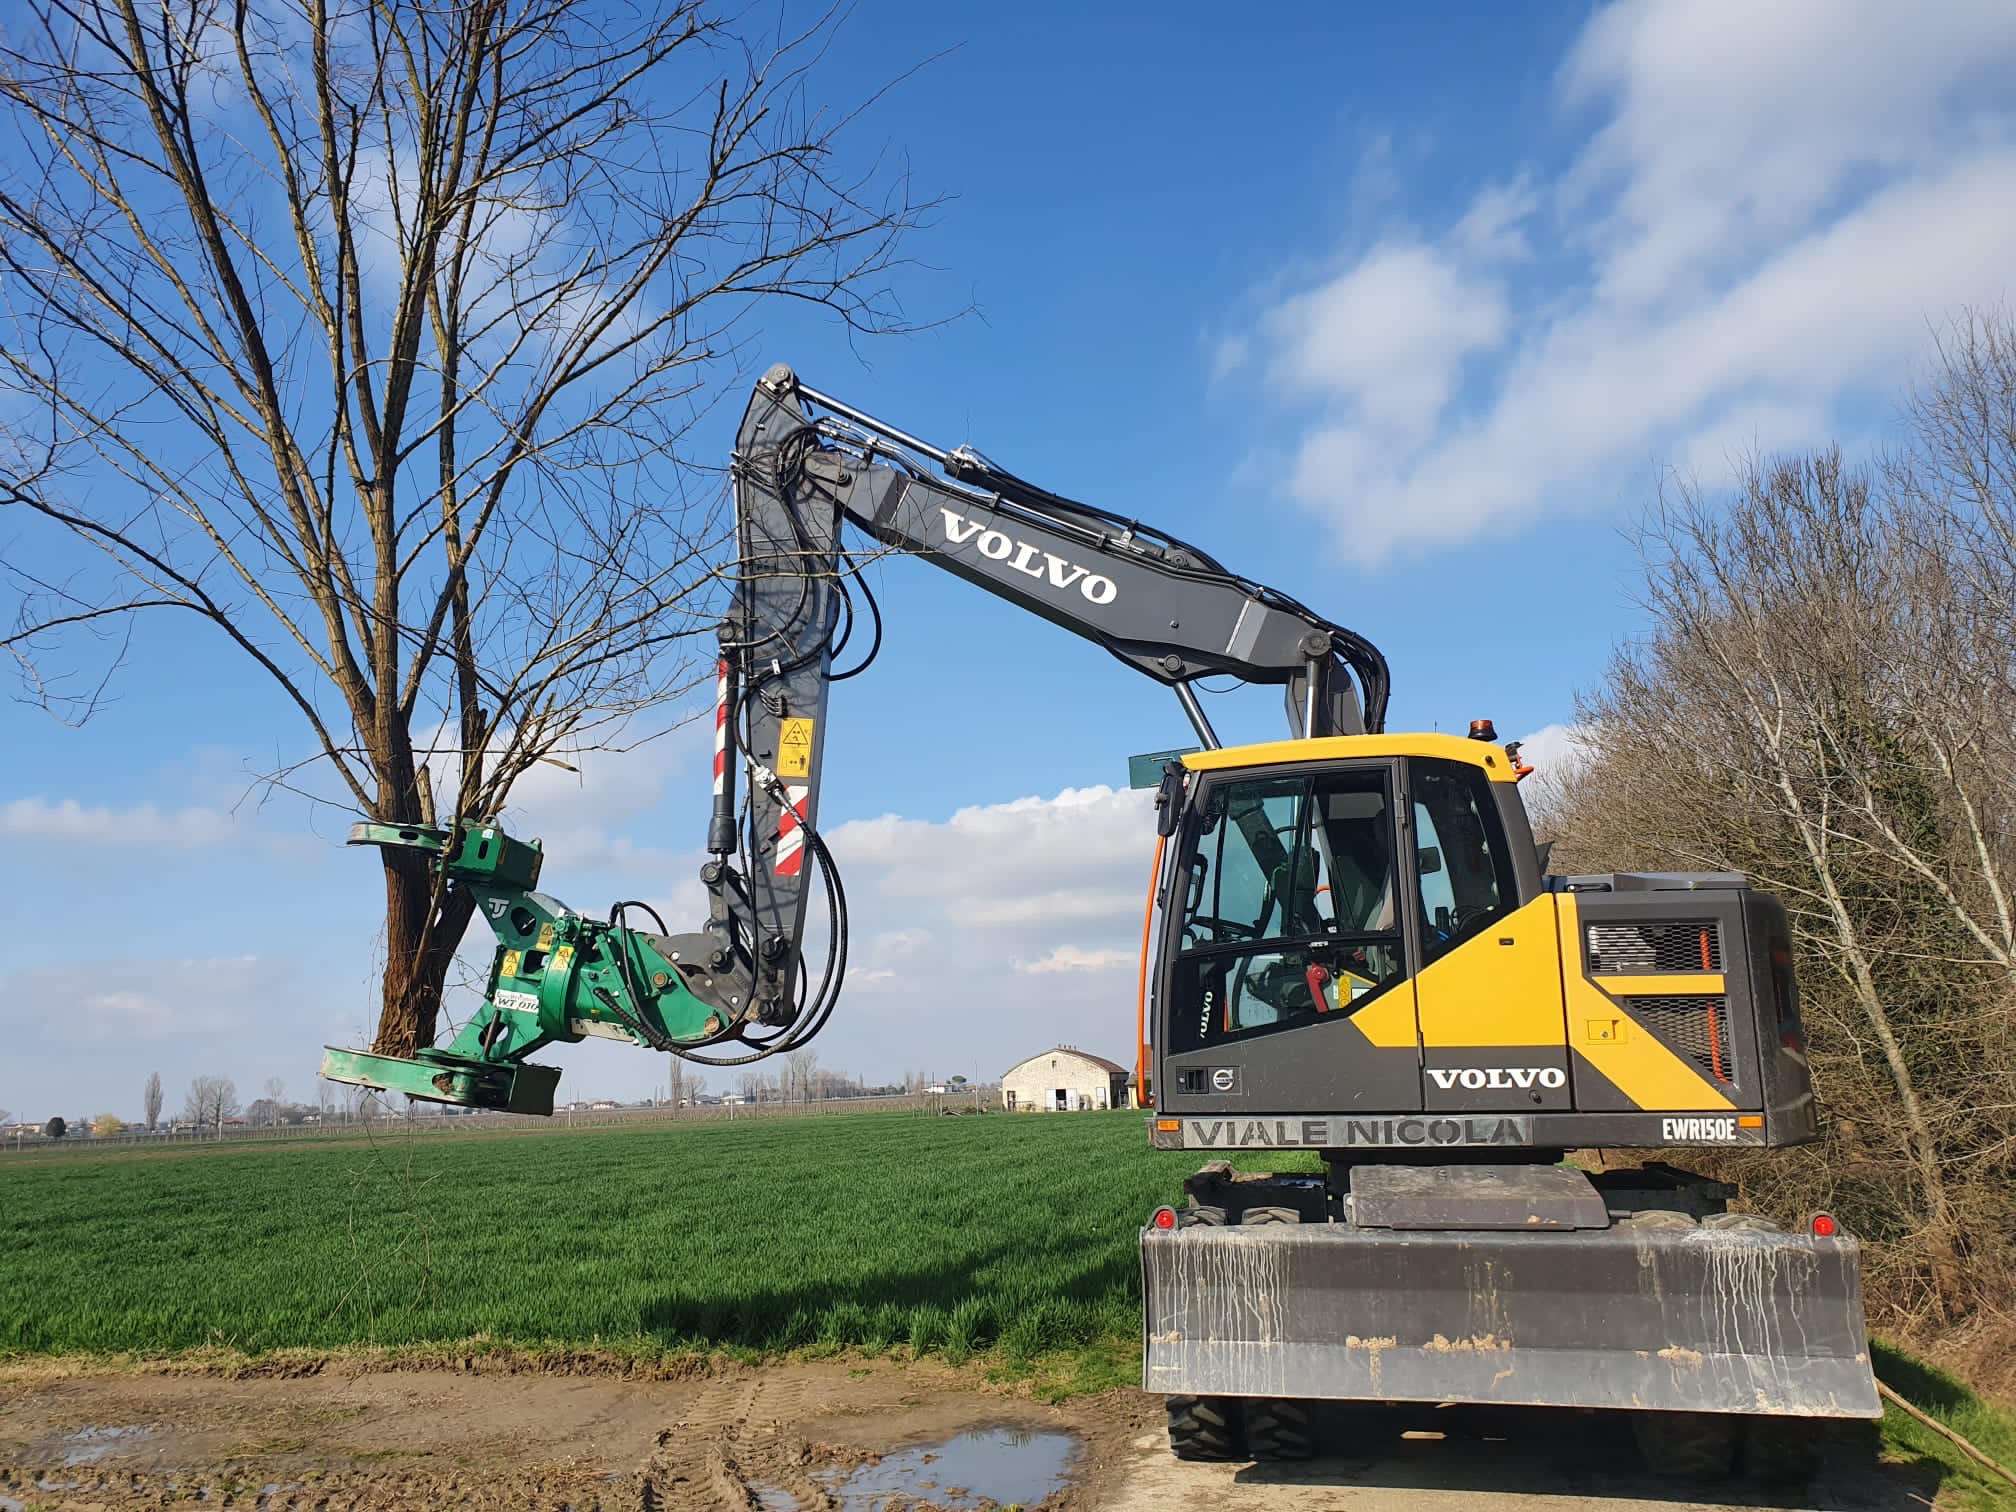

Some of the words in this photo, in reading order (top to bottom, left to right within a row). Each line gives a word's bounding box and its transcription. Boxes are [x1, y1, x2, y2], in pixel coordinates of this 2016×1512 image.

[940, 507, 1118, 604] VOLVO
[1427, 1068, 1566, 1089] VOLVO
[1191, 1121, 1328, 1145] VIALE
[1347, 1119, 1524, 1145] NICOLA
[1662, 1118, 1737, 1140] EWR150E
